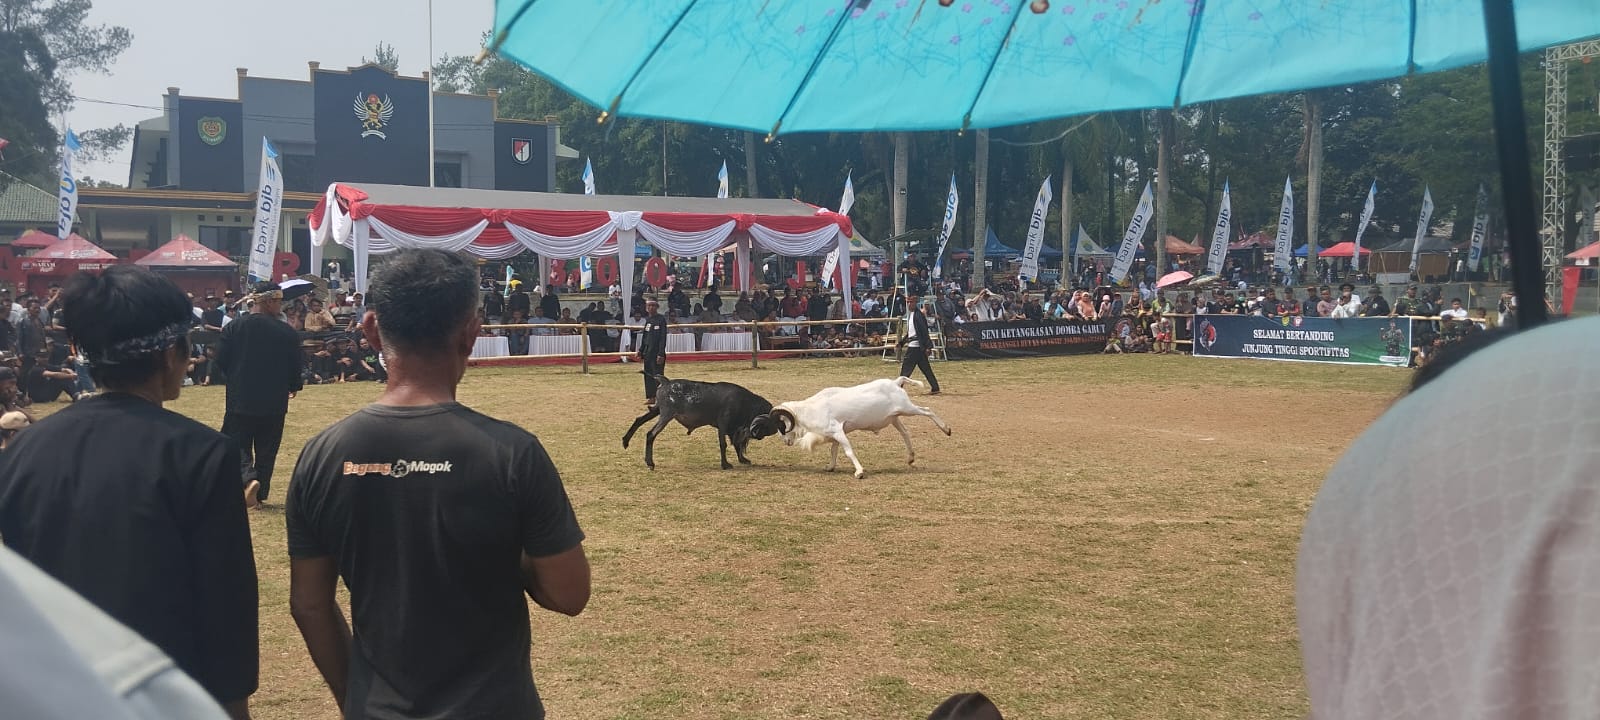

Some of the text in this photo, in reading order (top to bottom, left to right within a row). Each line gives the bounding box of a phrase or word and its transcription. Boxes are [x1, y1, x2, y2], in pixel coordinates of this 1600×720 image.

[260, 184, 273, 213] bjb
[255, 216, 270, 254] bank
[1025, 232, 1037, 260] bank
[1031, 209, 1042, 230] bjb
[1116, 237, 1135, 263] bank
[1129, 214, 1143, 234] bjb
[1211, 208, 1229, 257] bank bjb
[1276, 207, 1291, 254] bank bjb
[981, 328, 999, 340] SENI
[1000, 326, 1054, 339] KETANGKASAN
[1055, 325, 1081, 335] DOMBA
[1082, 324, 1106, 334] GARUT
[1253, 329, 1334, 341] SELAMAT BERTANDING
[1242, 343, 1273, 354] JUNJUNG
[1274, 344, 1298, 355] TINGGI
[410, 460, 453, 474] Mogok
